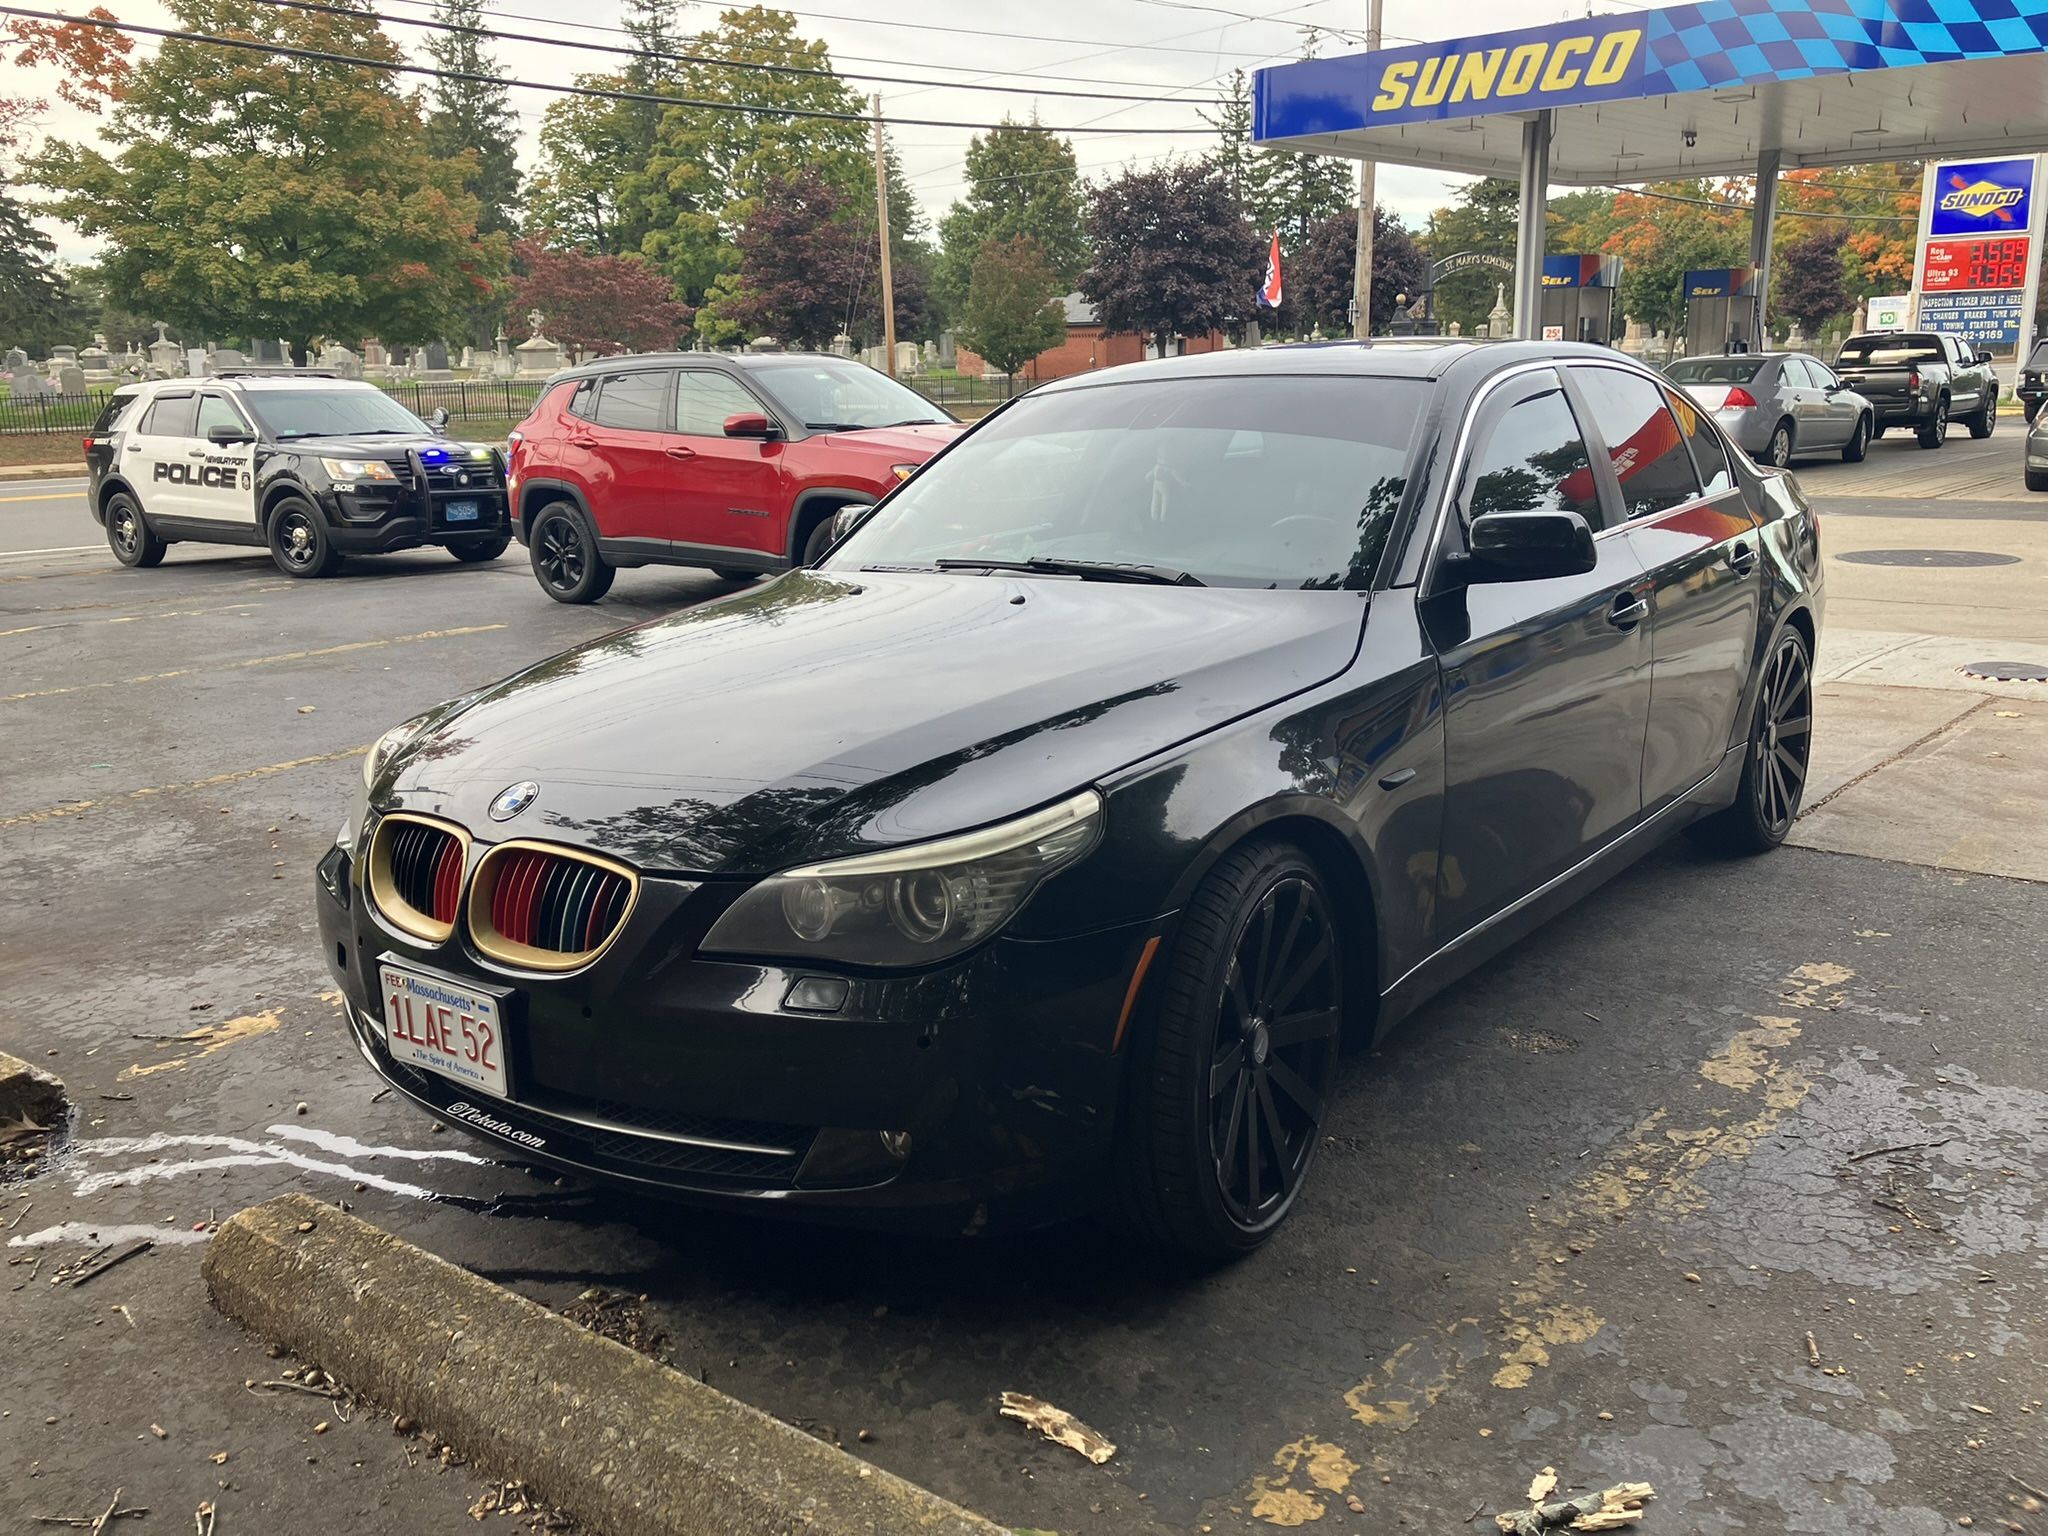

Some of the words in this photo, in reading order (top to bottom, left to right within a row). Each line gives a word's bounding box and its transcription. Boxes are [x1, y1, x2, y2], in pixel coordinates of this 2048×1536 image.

[1371, 29, 1642, 112] SUNOCO
[1943, 190, 2021, 208] SUNOCO
[1927, 269, 1946, 278] Ultra
[1948, 268, 1959, 278] 93
[1955, 296, 1979, 306] STICKER
[2006, 294, 2022, 305] HERE
[1921, 311, 1931, 321] OIL
[1933, 311, 1959, 321] CHANGES
[1964, 310, 1987, 320] BRAKES
[1921, 322, 1938, 331] TIRES
[1943, 321, 1964, 331] TOWING
[1969, 320, 1999, 329] STARTERS
[153, 462, 238, 489] POLICE
[333, 483, 356, 492] 505
[406, 976, 472, 1012] Massachusetts
[389, 992, 459, 1057] 1LAE
[460, 1012, 498, 1072] 52
[415, 1048, 428, 1060] The
[428, 1053, 445, 1068] Spirit
[446, 1060, 454, 1072] of
[453, 1062, 480, 1081] America
